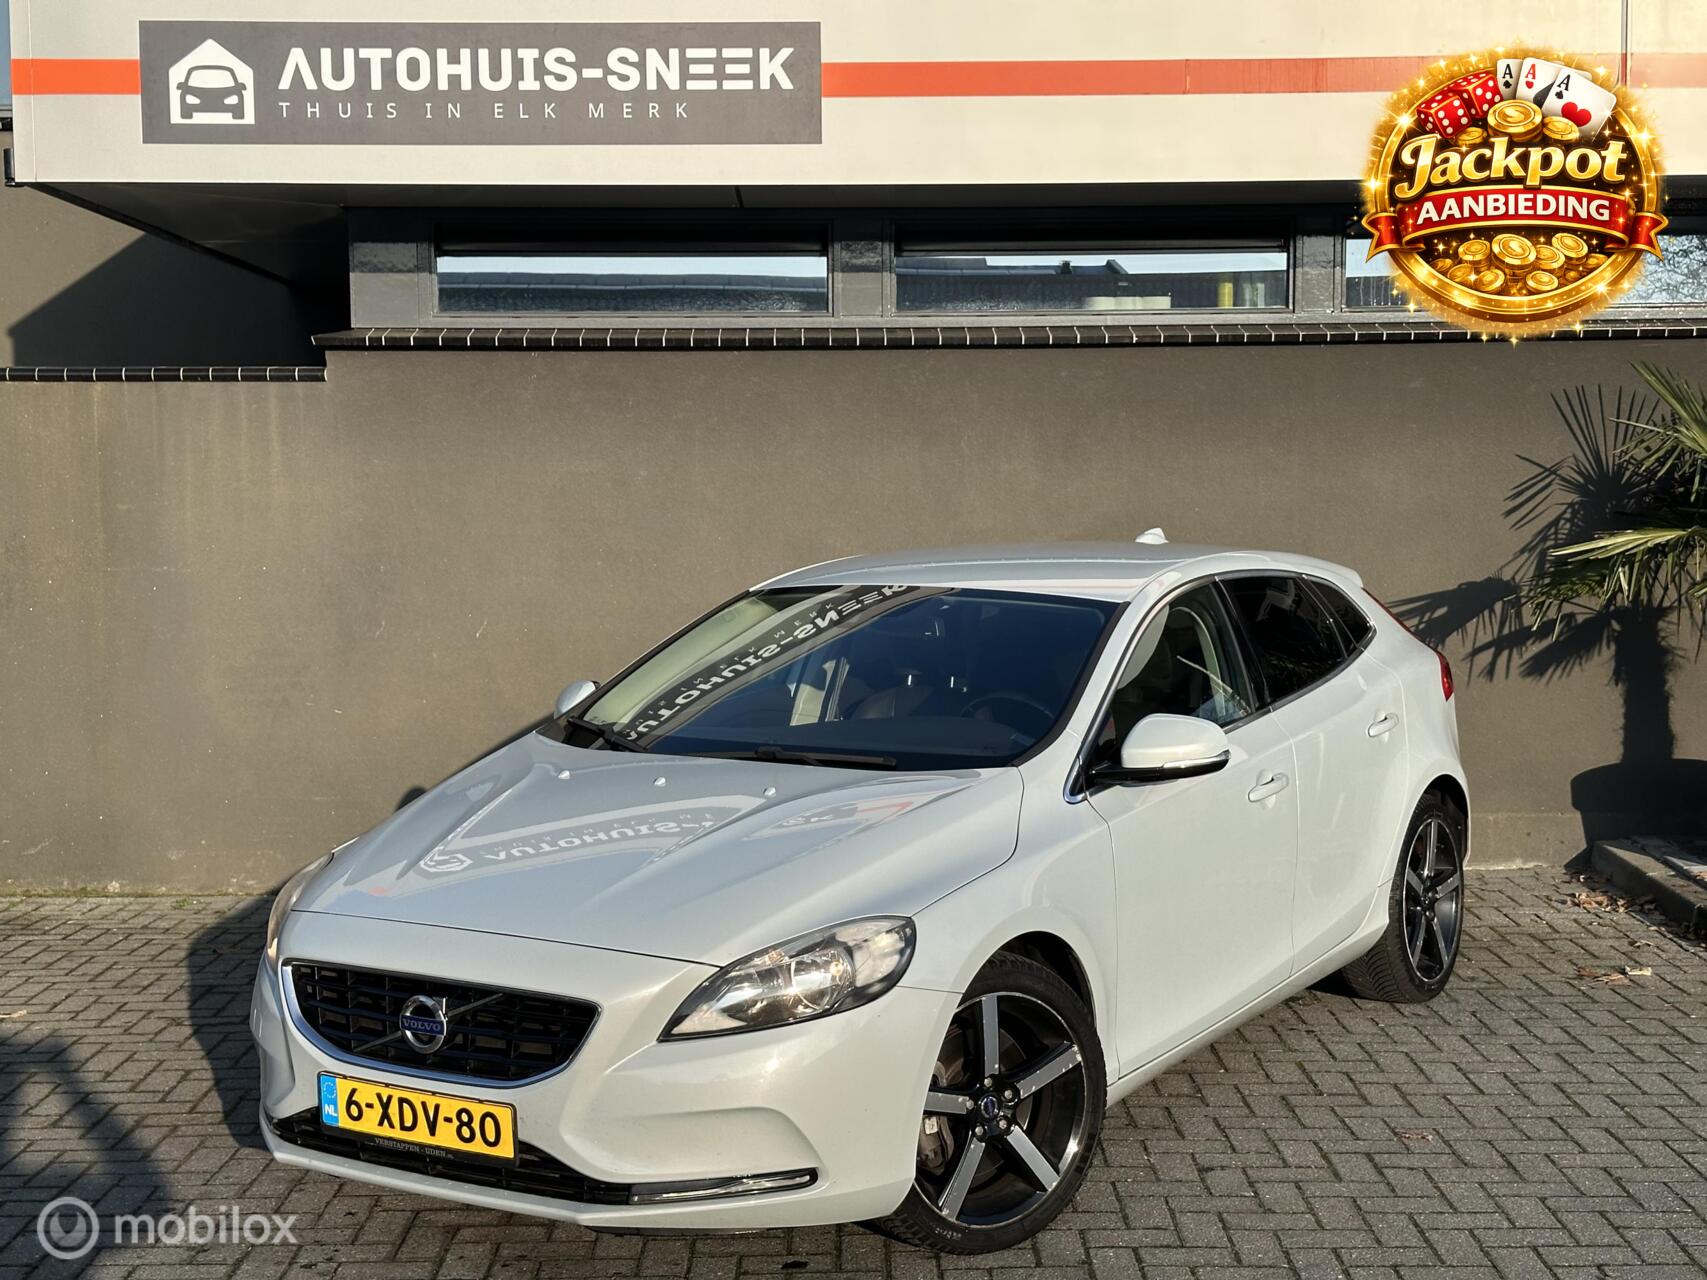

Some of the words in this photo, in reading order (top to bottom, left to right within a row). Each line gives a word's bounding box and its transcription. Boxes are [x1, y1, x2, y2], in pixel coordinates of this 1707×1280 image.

[278, 46, 795, 92] AUTOHUIS-SNEEK
[279, 102, 398, 119] THUIS
[425, 102, 461, 119] IN
[495, 102, 557, 119] ELK
[588, 102, 689, 119] MERK
[402, 1016, 442, 1032] VOLVO
[324, 1103, 339, 1117] NL
[345, 1087, 502, 1148] 6-XDV-80
